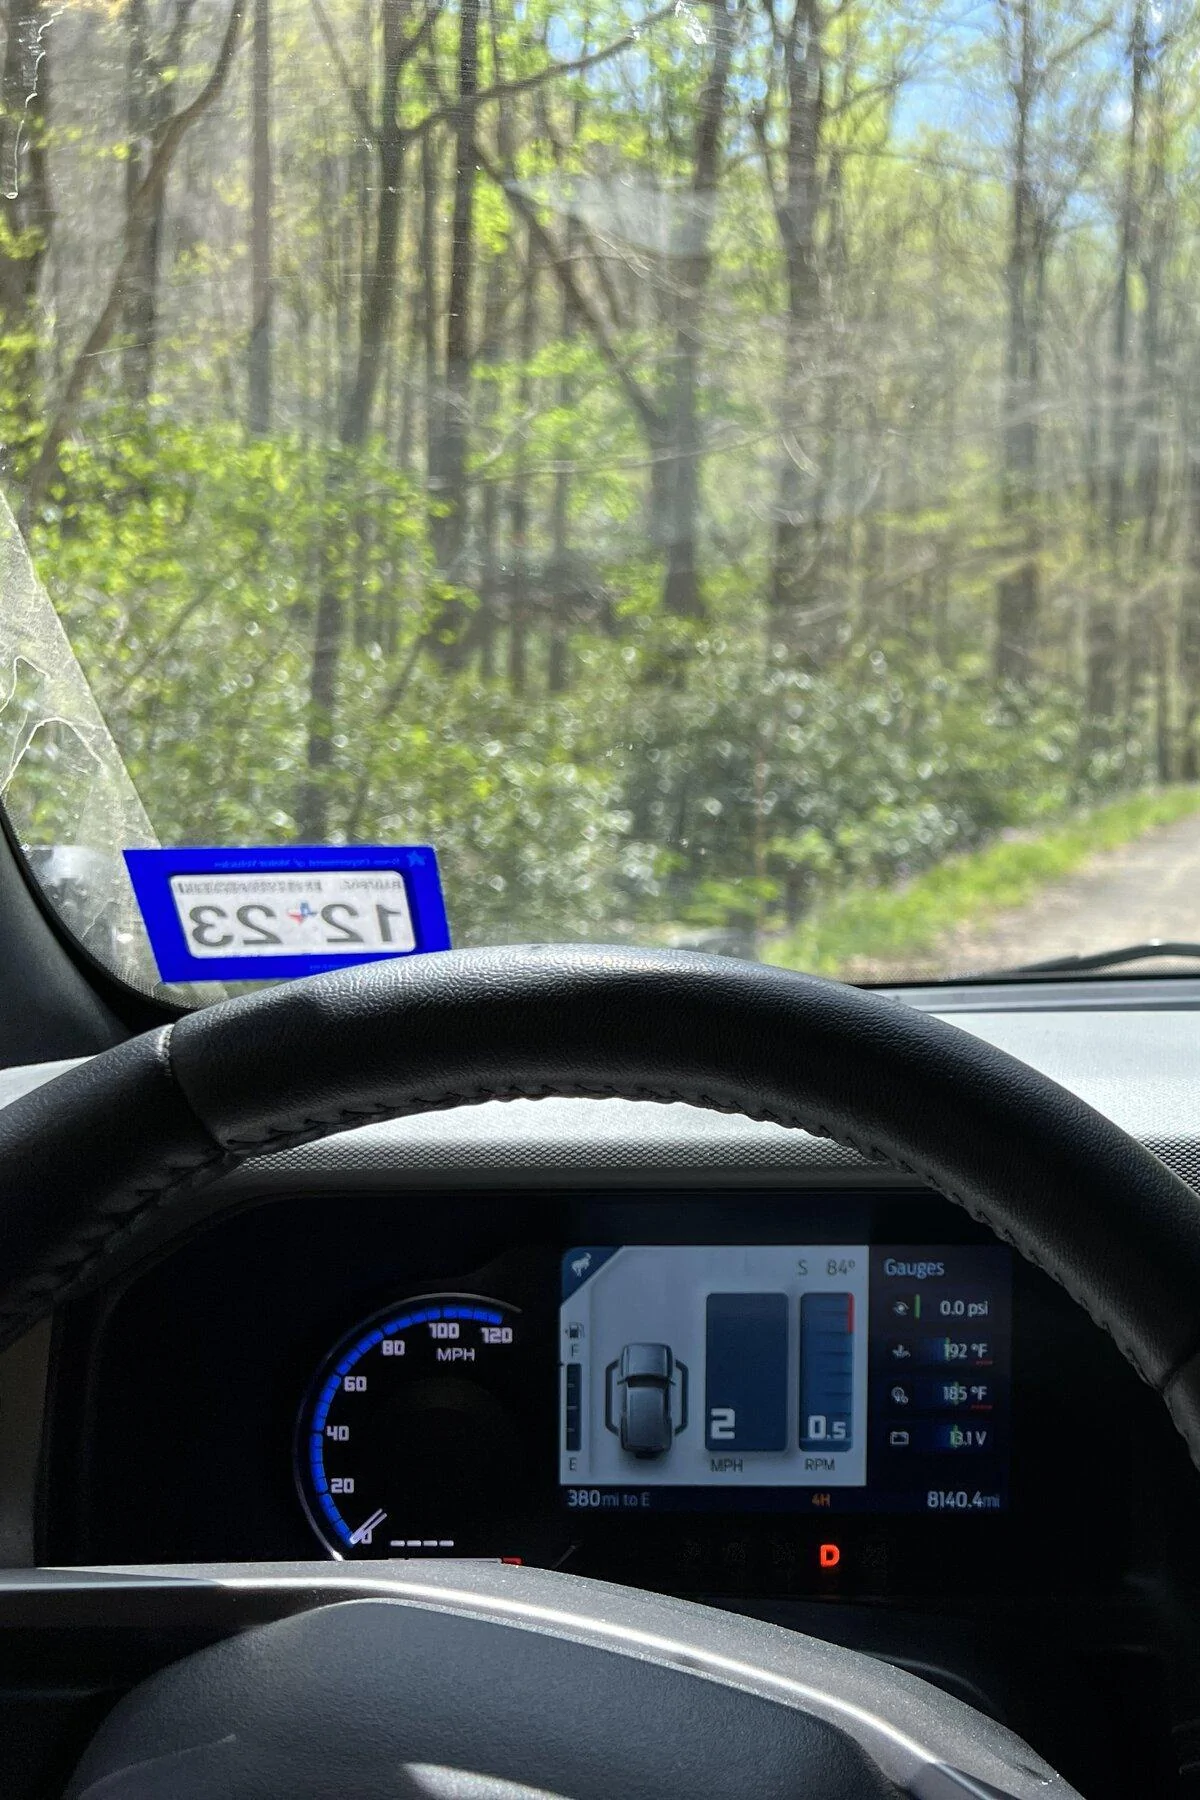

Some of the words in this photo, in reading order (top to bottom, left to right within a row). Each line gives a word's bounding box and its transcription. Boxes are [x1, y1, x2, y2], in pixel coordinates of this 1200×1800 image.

[884, 1258, 945, 1279] Gauges
[940, 1300, 965, 1316] 0.0
[968, 1300, 989, 1317] psi
[429, 1323, 460, 1339] 100
[481, 1327, 513, 1344] 120
[382, 1340, 405, 1356] 80
[436, 1347, 475, 1361] MPH
[344, 1376, 367, 1392] 60
[711, 1408, 735, 1440] 2
[808, 1415, 846, 1440] 0.5
[326, 1425, 350, 1441] 40
[976, 1431, 987, 1445] V
[569, 1457, 577, 1471] E
[711, 1459, 743, 1472] MPH
[805, 1458, 835, 1471] RPM
[331, 1478, 354, 1494] 20
[623, 1493, 639, 1506] to
[642, 1492, 650, 1506] E
[812, 1494, 831, 1507] 4H
[820, 1544, 840, 1567] D
